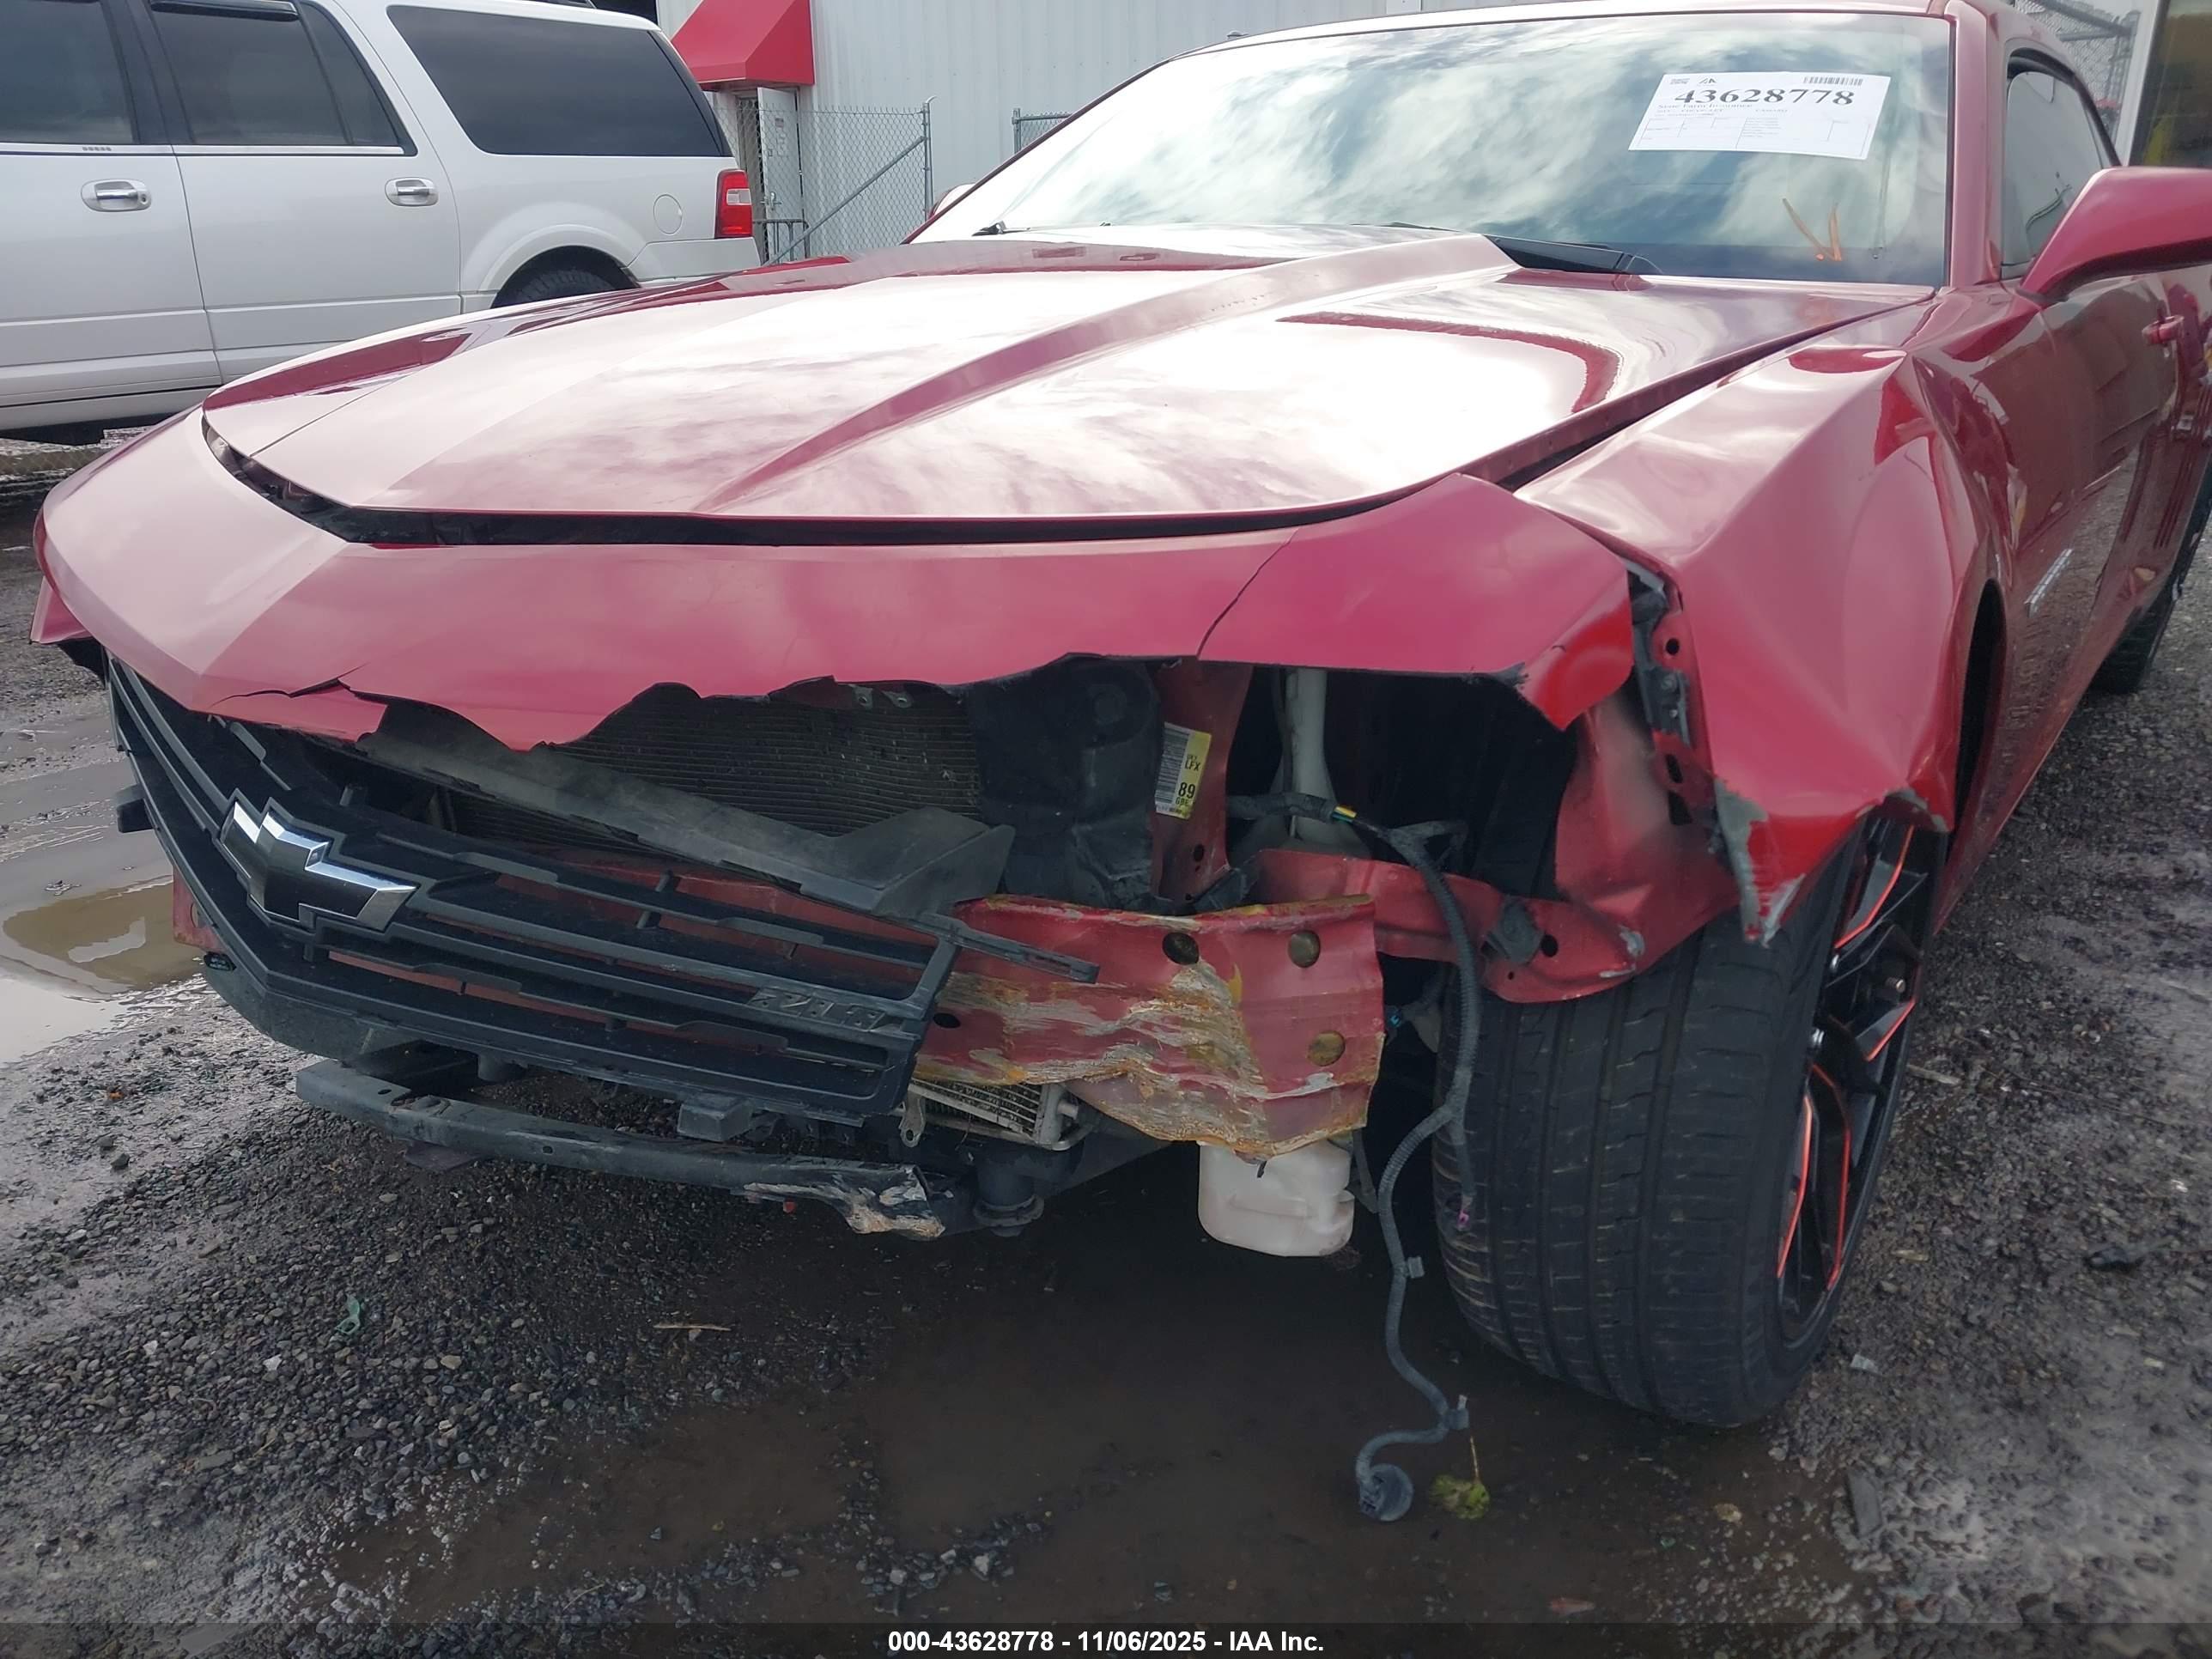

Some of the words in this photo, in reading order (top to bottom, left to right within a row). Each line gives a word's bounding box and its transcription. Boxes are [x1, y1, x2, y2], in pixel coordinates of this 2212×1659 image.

[1674, 88, 1855, 106] 43628778
[1185, 759, 1201, 771] LFX
[1178, 782, 1196, 799] 89
